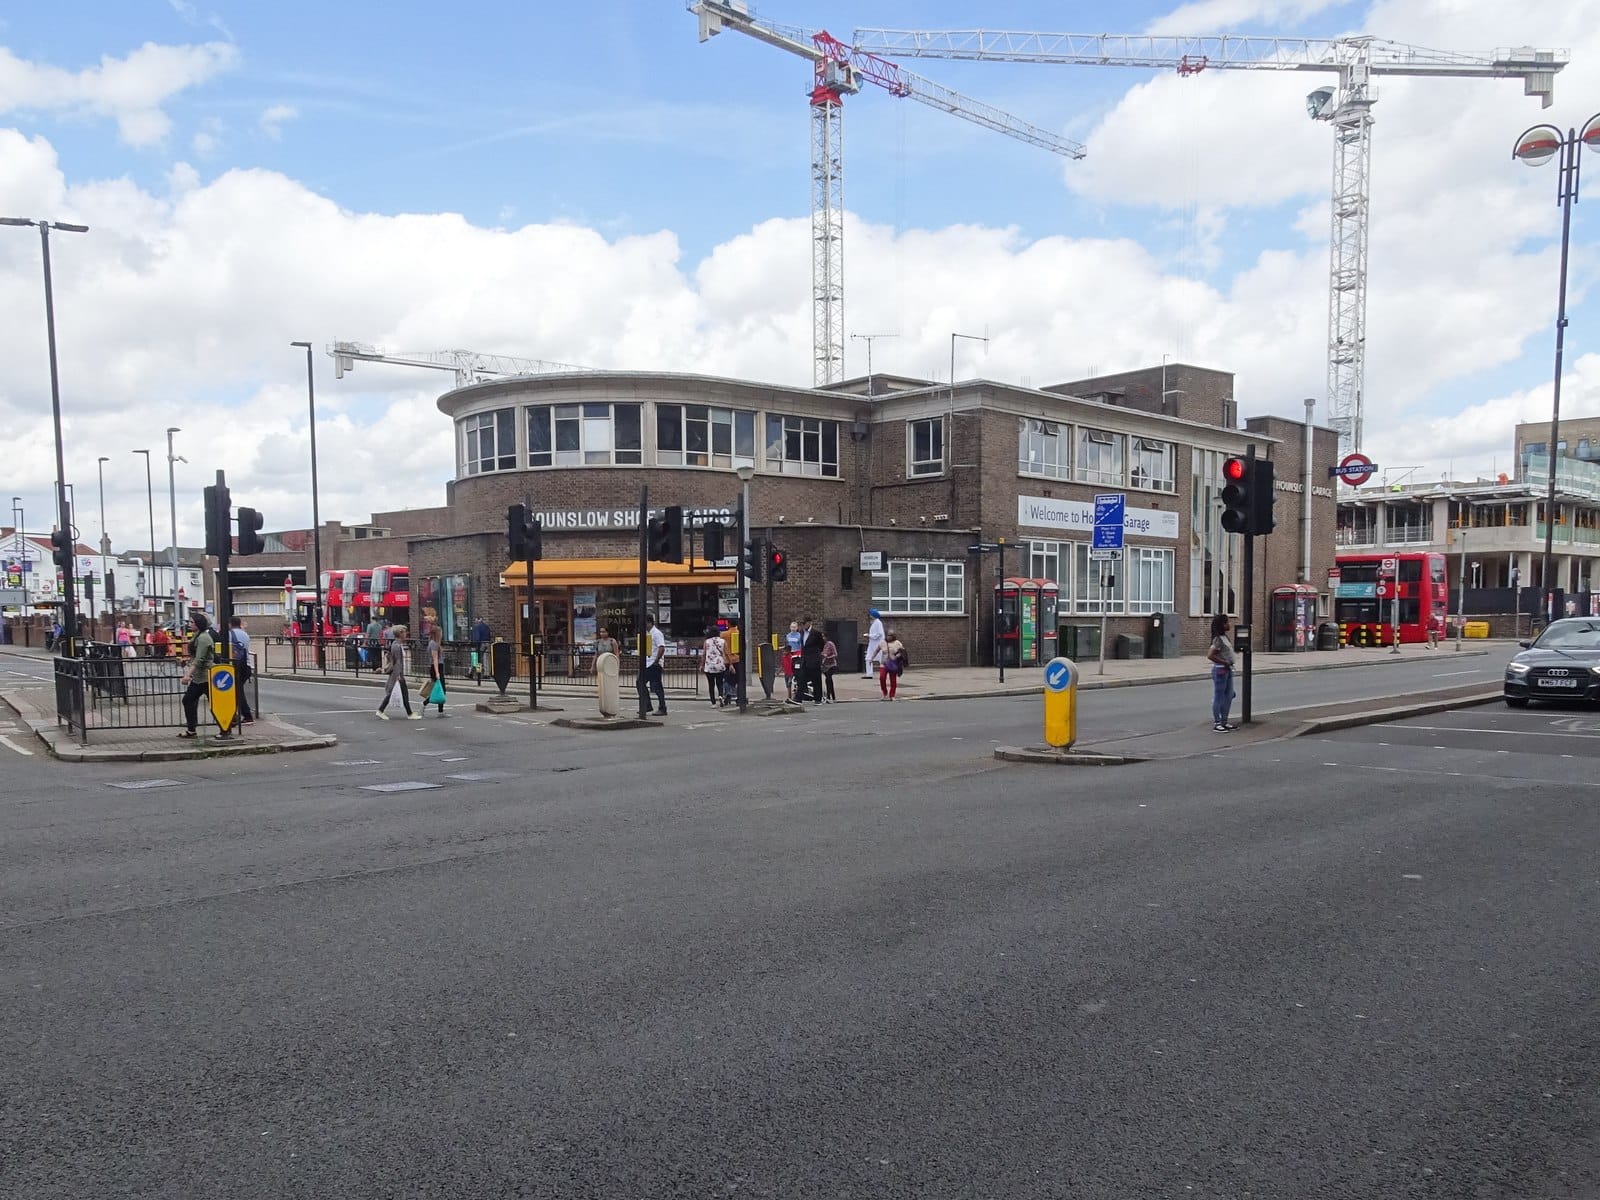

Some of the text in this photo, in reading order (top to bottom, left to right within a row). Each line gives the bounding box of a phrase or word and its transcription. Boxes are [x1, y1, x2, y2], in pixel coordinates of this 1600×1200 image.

[1349, 465, 1375, 473] STATION
[1275, 480, 1304, 494] HOUNSLO
[1030, 504, 1069, 522] Welcome
[1071, 511, 1080, 523] to
[531, 511, 609, 528] OUNSLOW
[602, 608, 627, 616] SHOE
[608, 617, 632, 625] PAIRS
